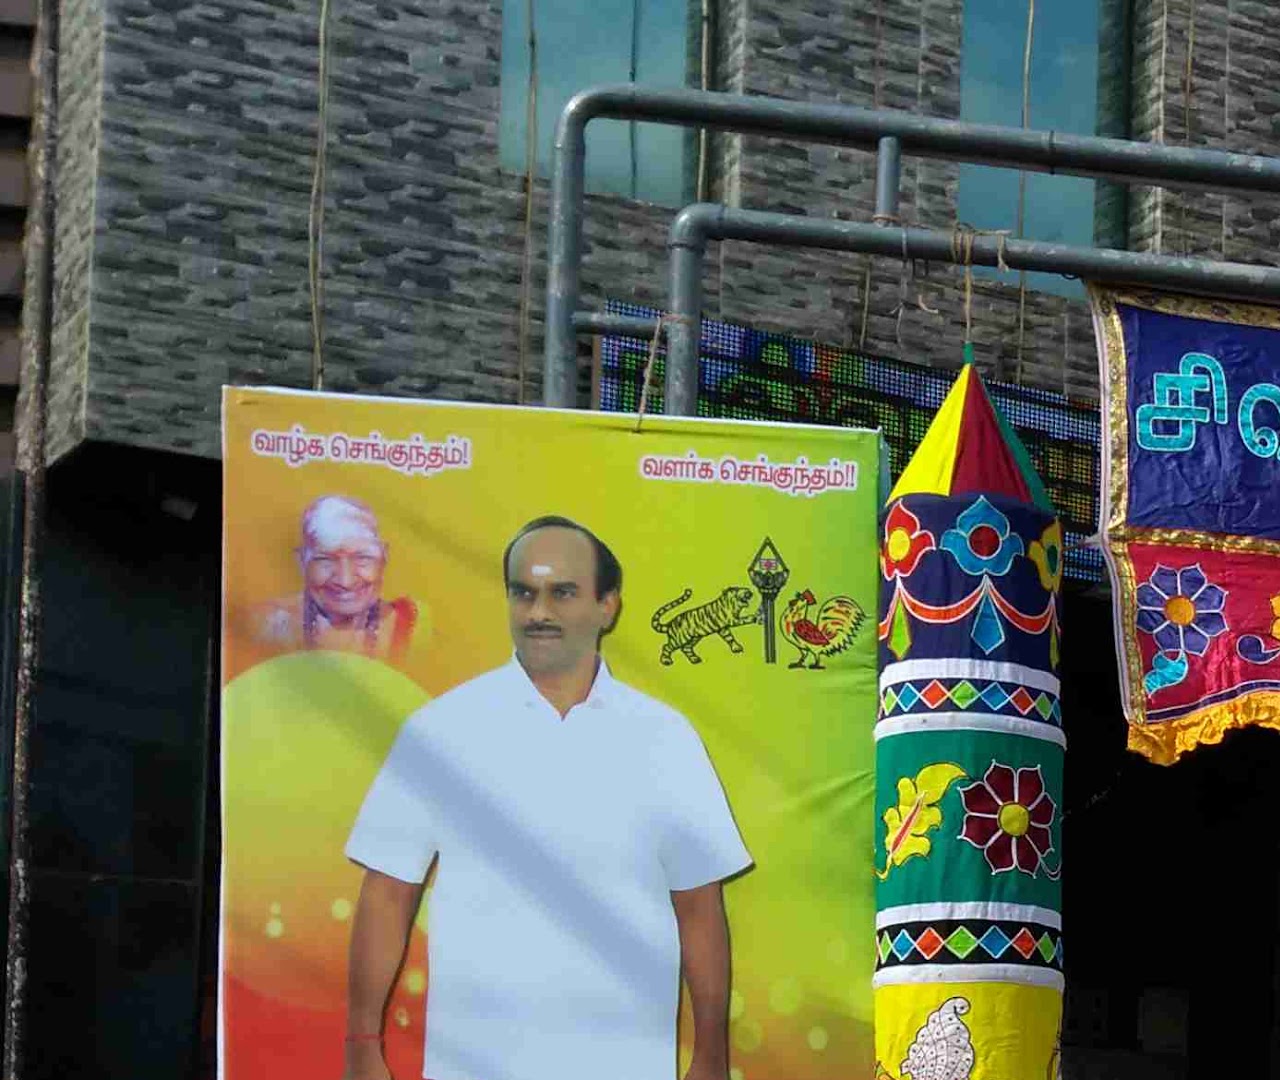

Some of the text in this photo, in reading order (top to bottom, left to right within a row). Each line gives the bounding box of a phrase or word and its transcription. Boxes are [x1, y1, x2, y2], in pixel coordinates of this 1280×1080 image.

[254, 428, 469, 475] வாழ்க செங்குந்தம்!
[643, 451, 856, 493] வளர்க செங்குந்தம்!!
